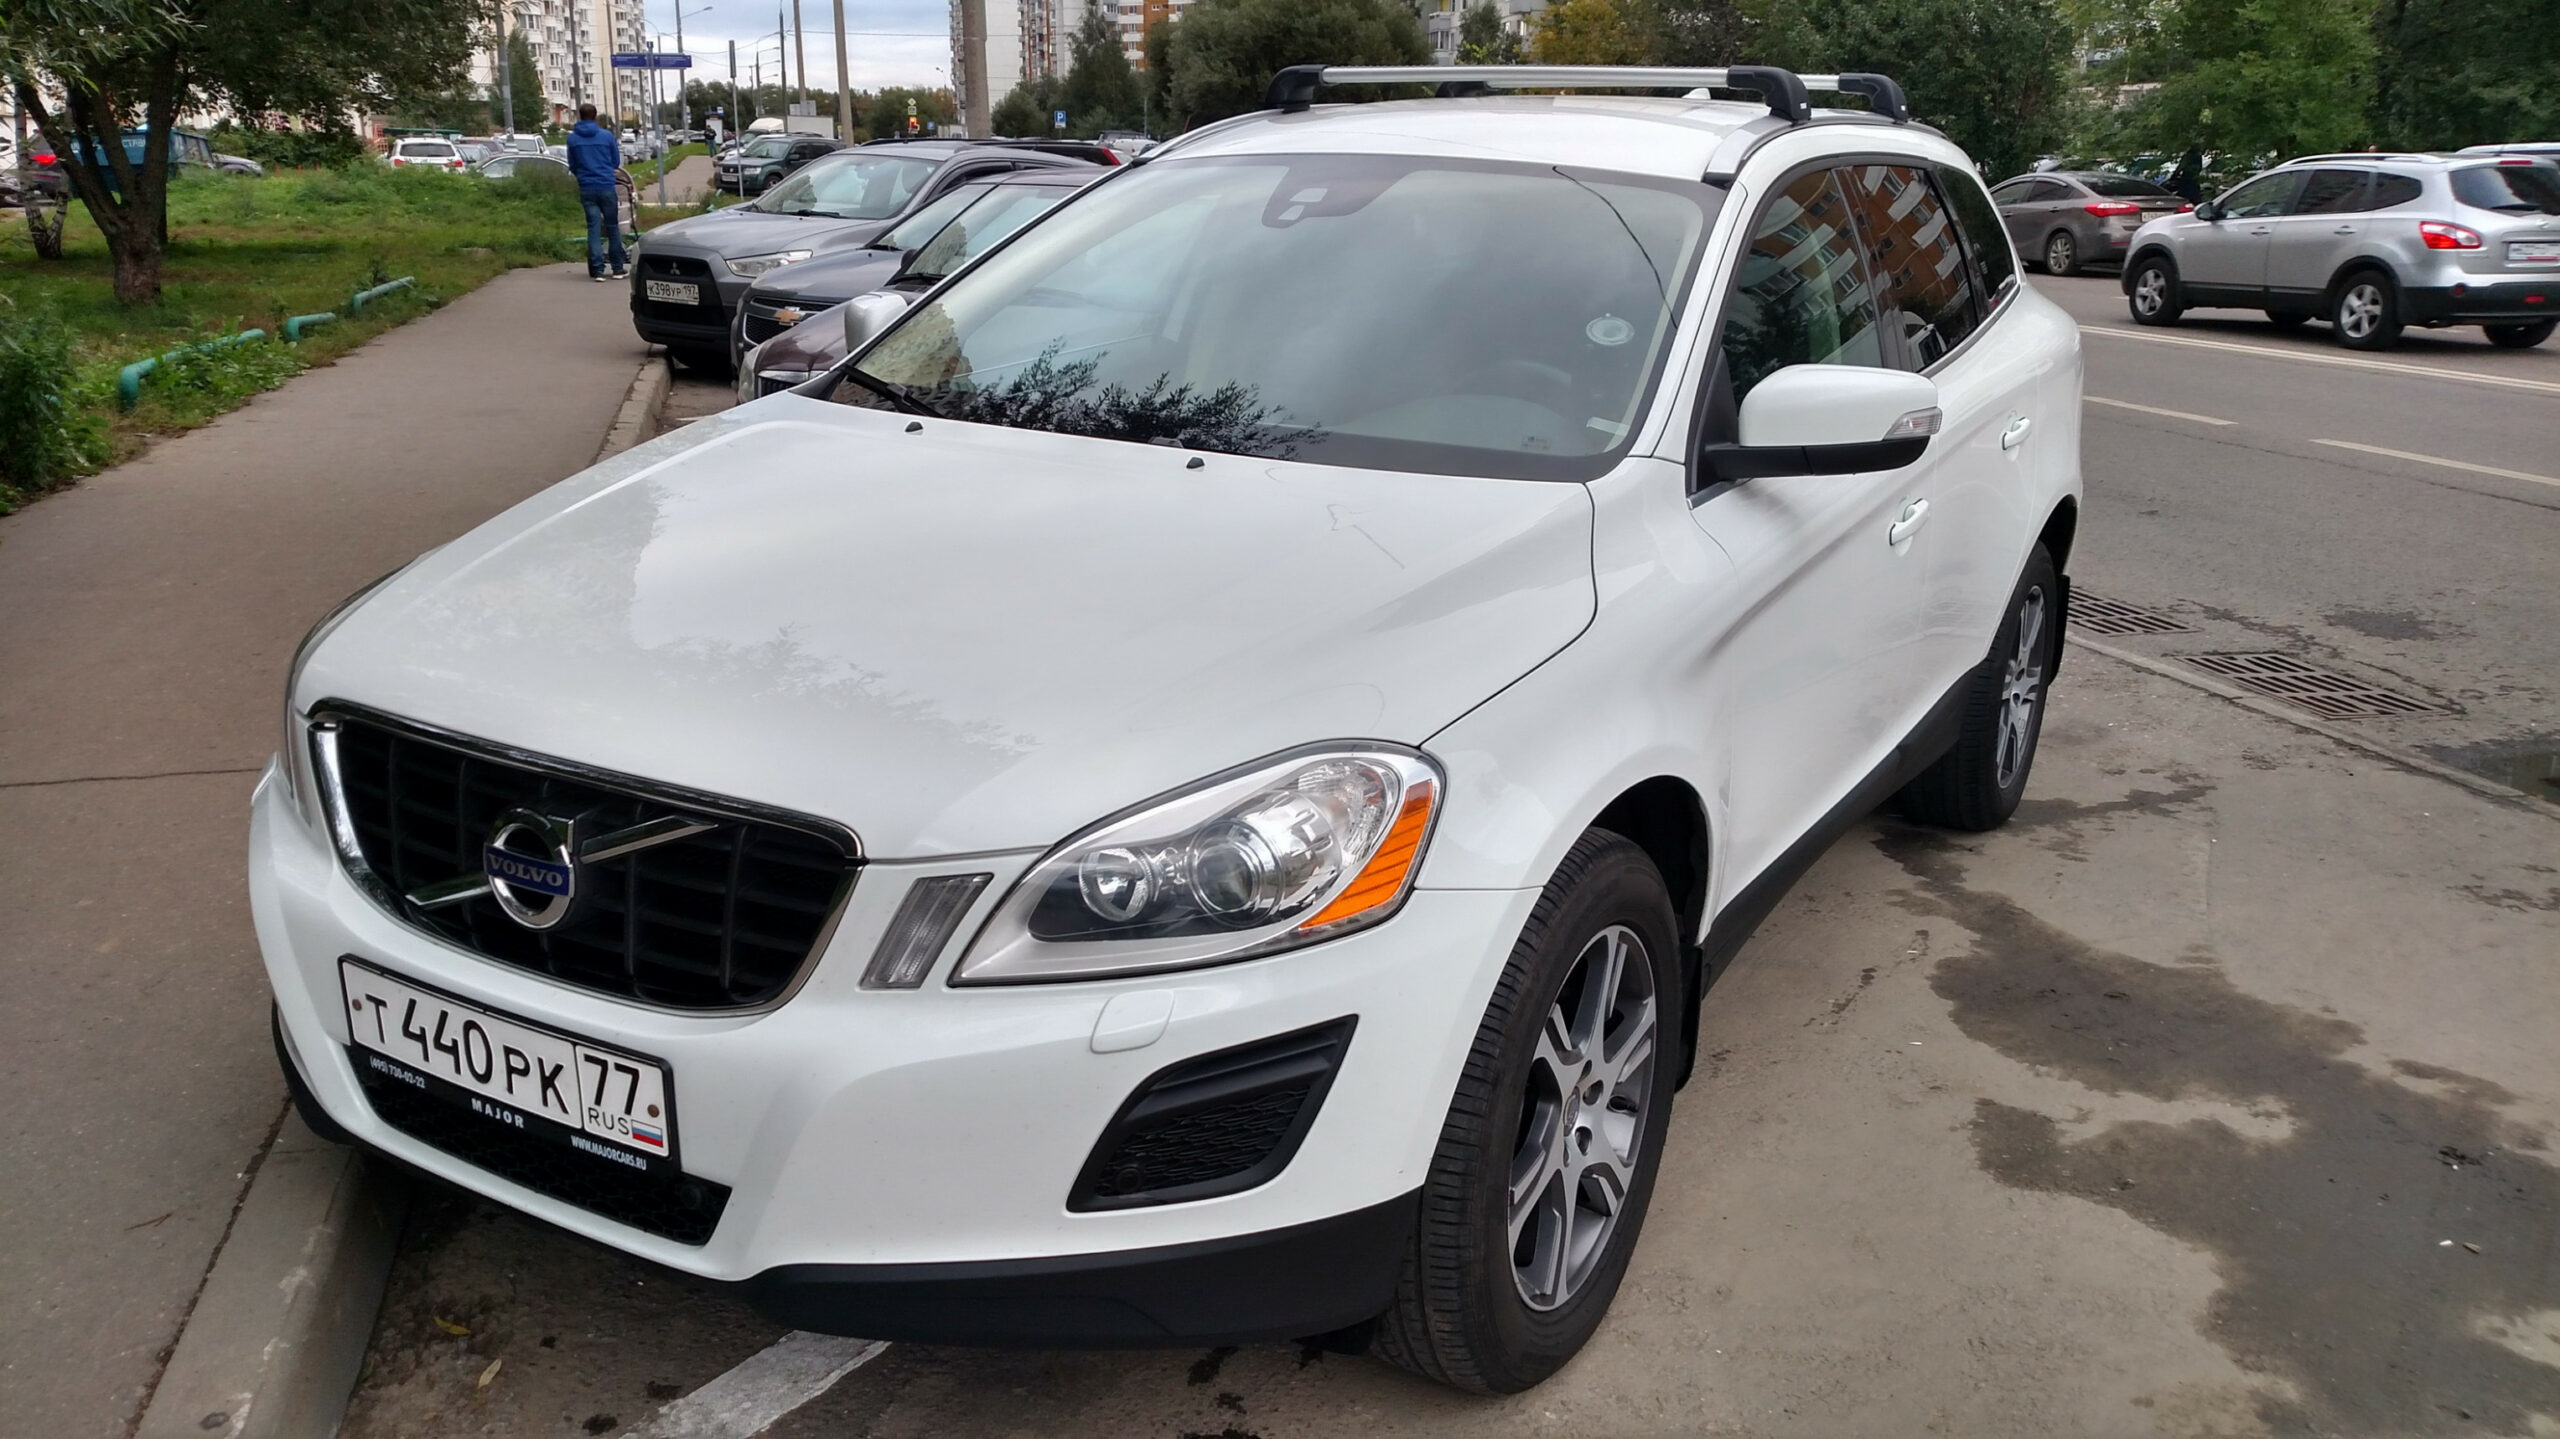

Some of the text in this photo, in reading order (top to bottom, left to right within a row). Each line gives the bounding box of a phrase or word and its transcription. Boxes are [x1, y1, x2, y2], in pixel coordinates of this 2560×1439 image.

[487, 853, 563, 887] VOLVO
[583, 1053, 640, 1116] 77
[471, 1098, 524, 1128] MAJOR
[588, 1107, 630, 1135] RUS
[570, 1135, 647, 1171] WWW.MAJORCARS.RU
